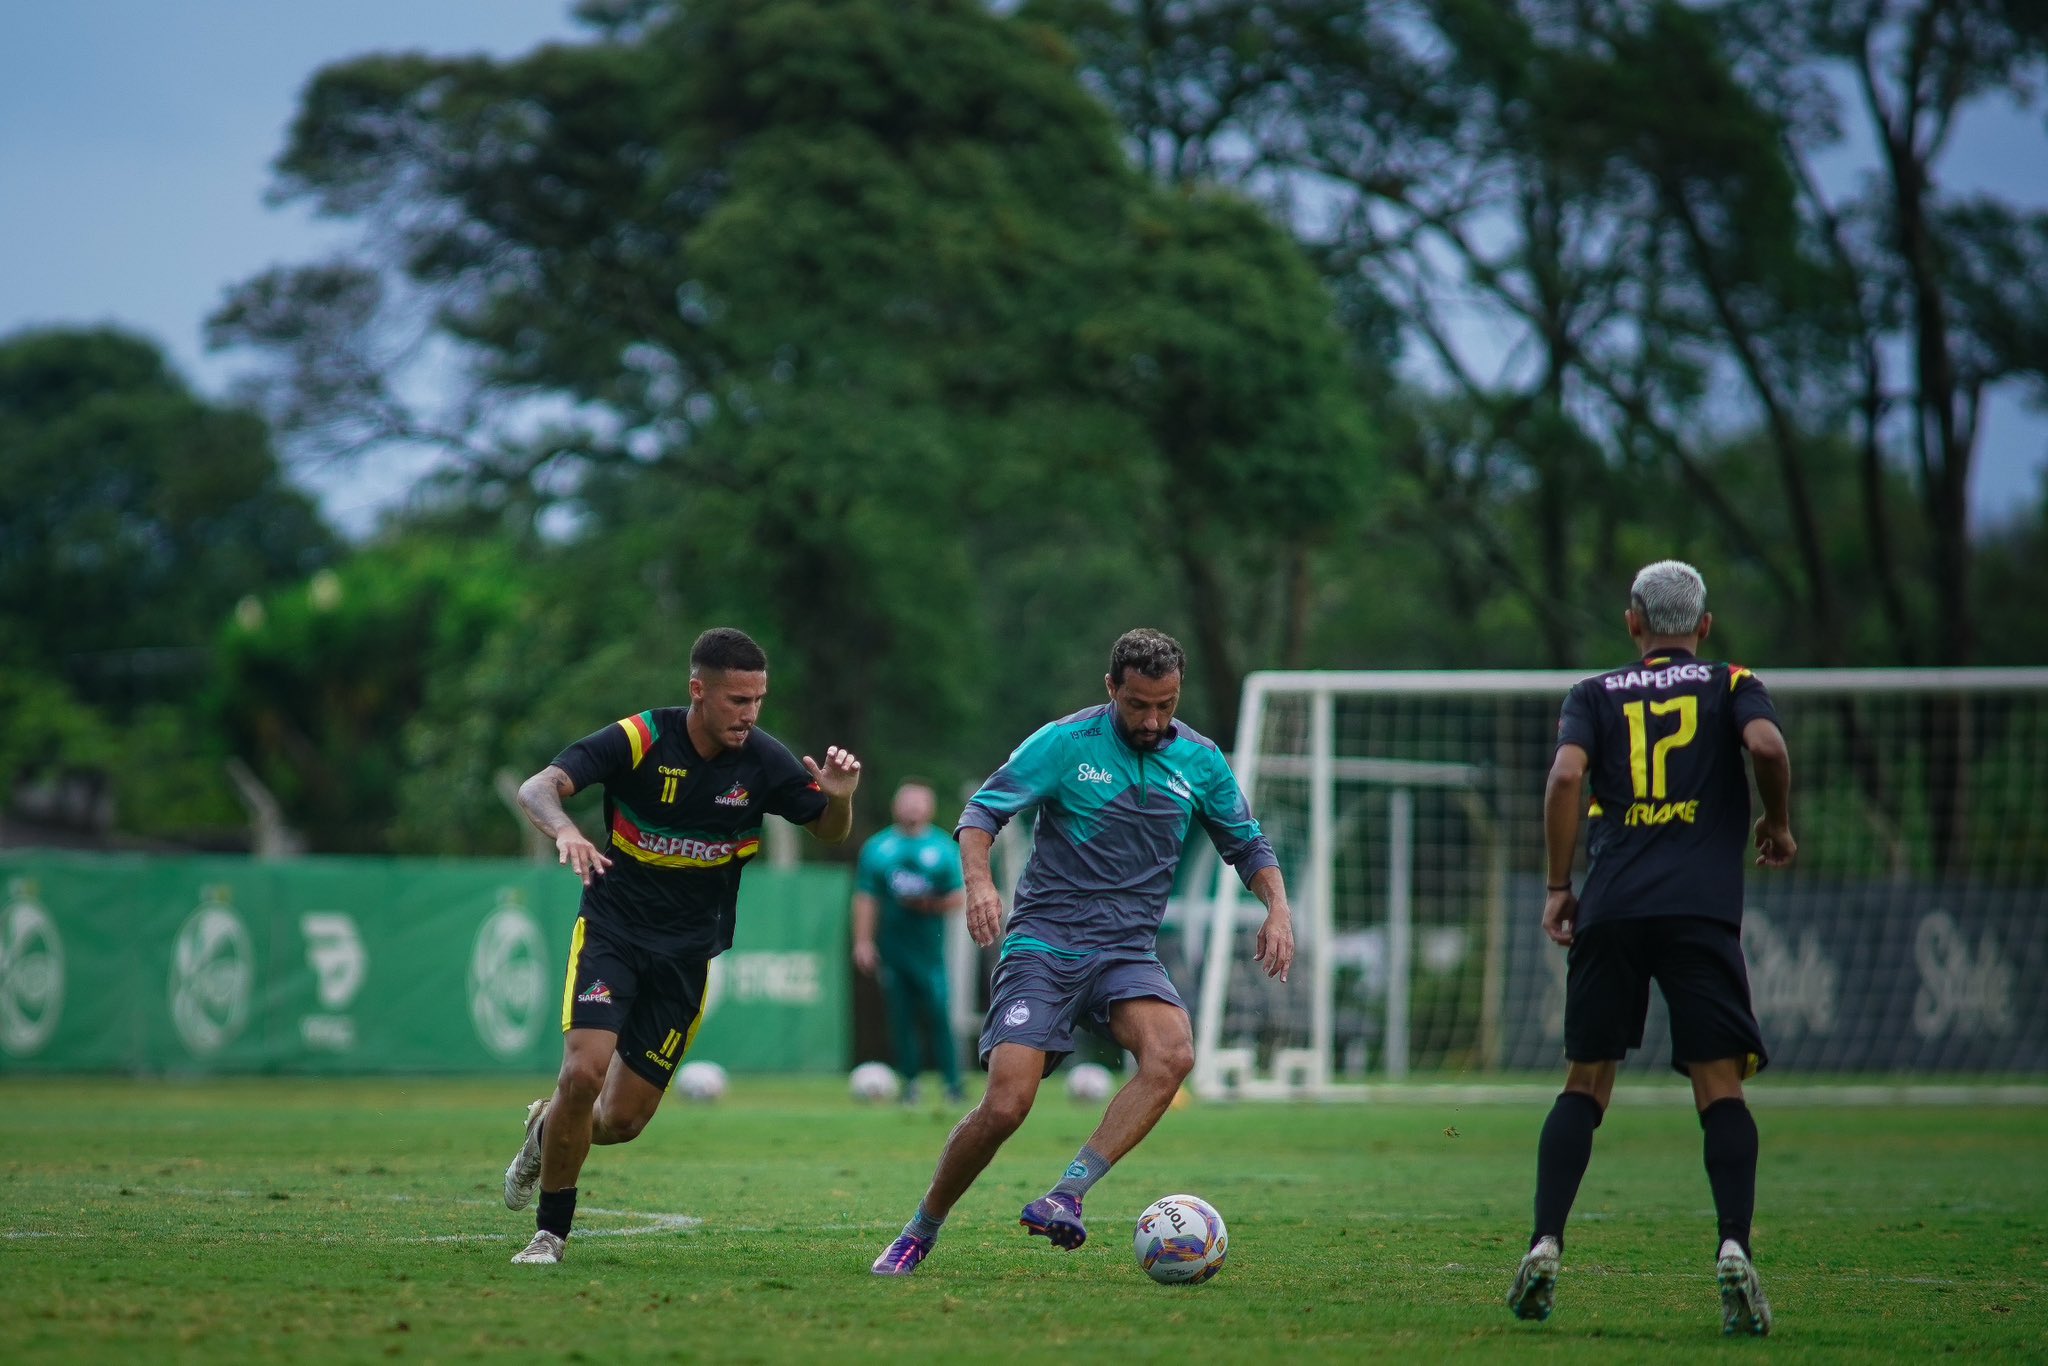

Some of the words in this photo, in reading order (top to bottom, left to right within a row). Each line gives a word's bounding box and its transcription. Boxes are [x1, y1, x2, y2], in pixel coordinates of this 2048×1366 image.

[1624, 695, 1698, 799] 17
[1078, 763, 1112, 784] Stake
[661, 777, 677, 804] 11
[660, 1028, 682, 1058] 11
